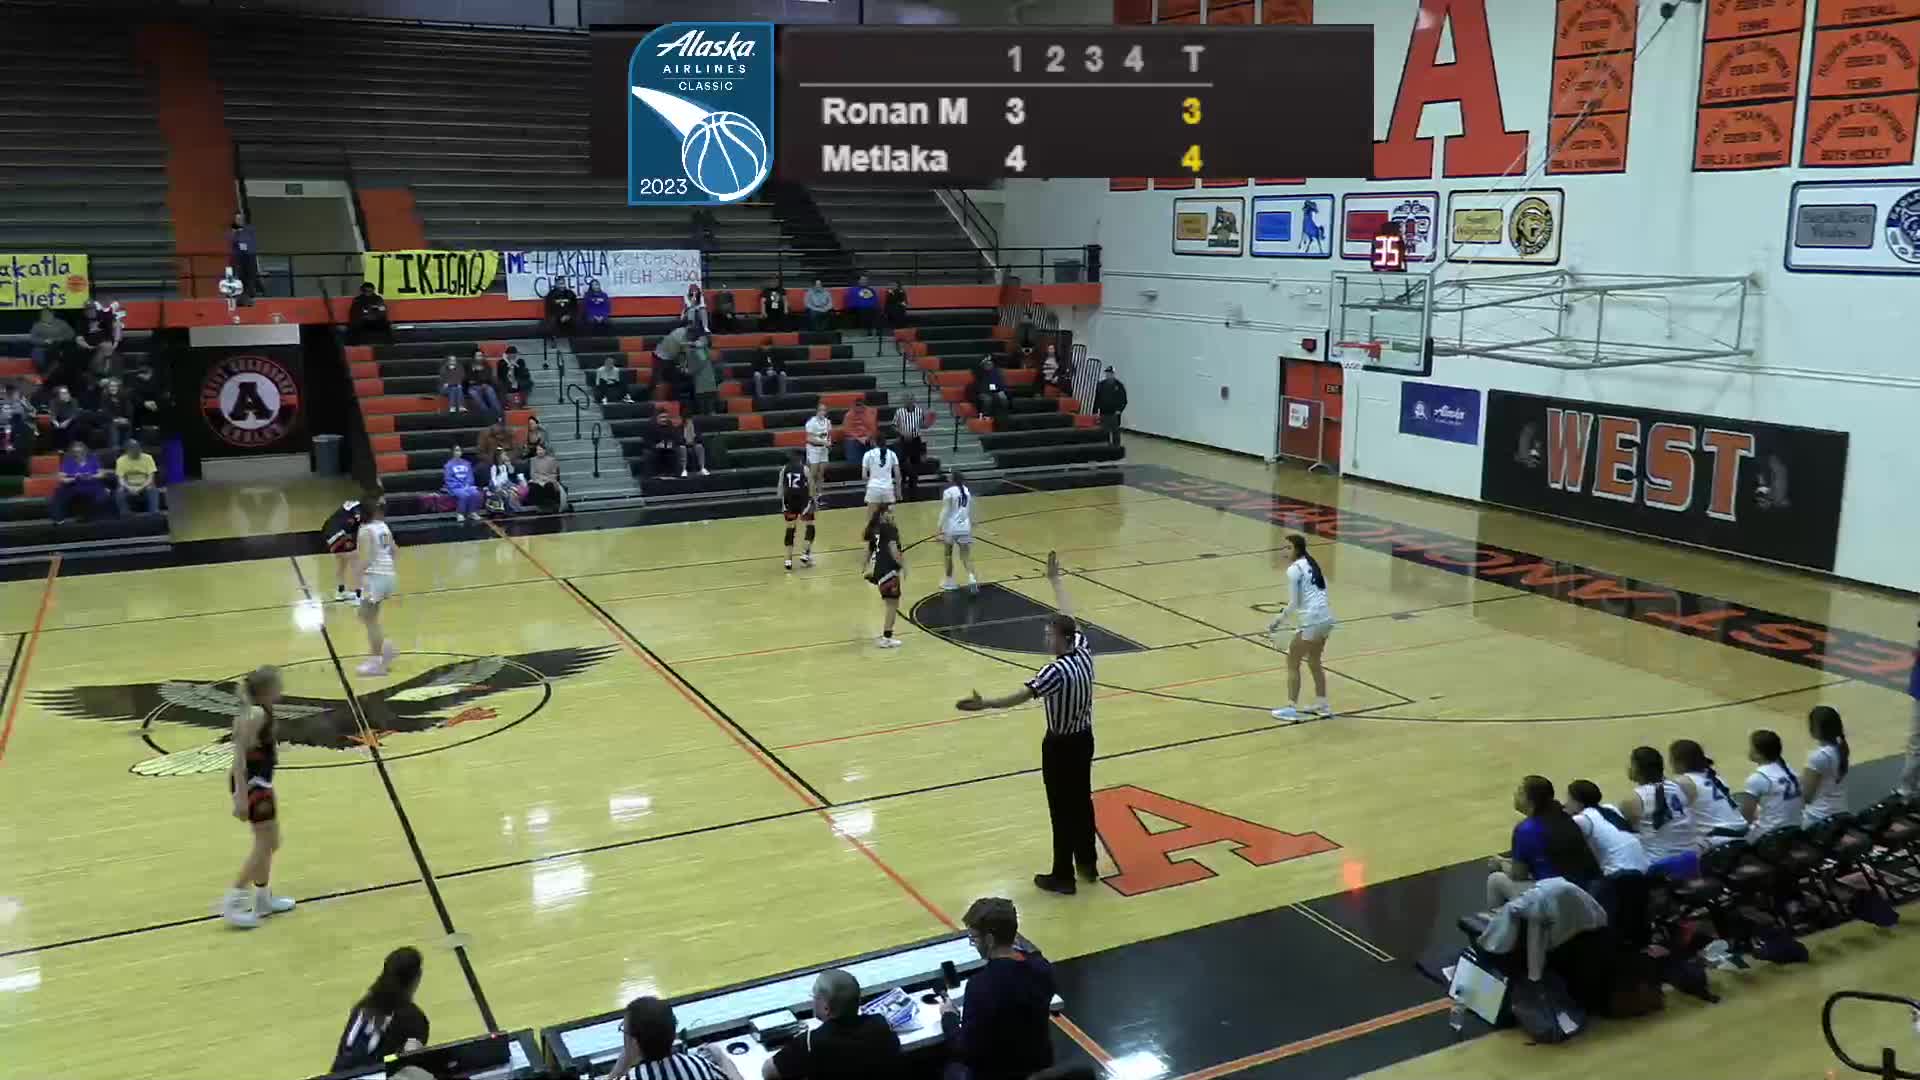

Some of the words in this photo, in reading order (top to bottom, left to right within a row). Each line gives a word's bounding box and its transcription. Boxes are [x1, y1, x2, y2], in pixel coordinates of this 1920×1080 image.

[372, 253, 488, 296] TIKIGAQ
[1374, 235, 1399, 266] 35
[1546, 407, 1756, 522] WEST
[1090, 784, 1344, 897] A
